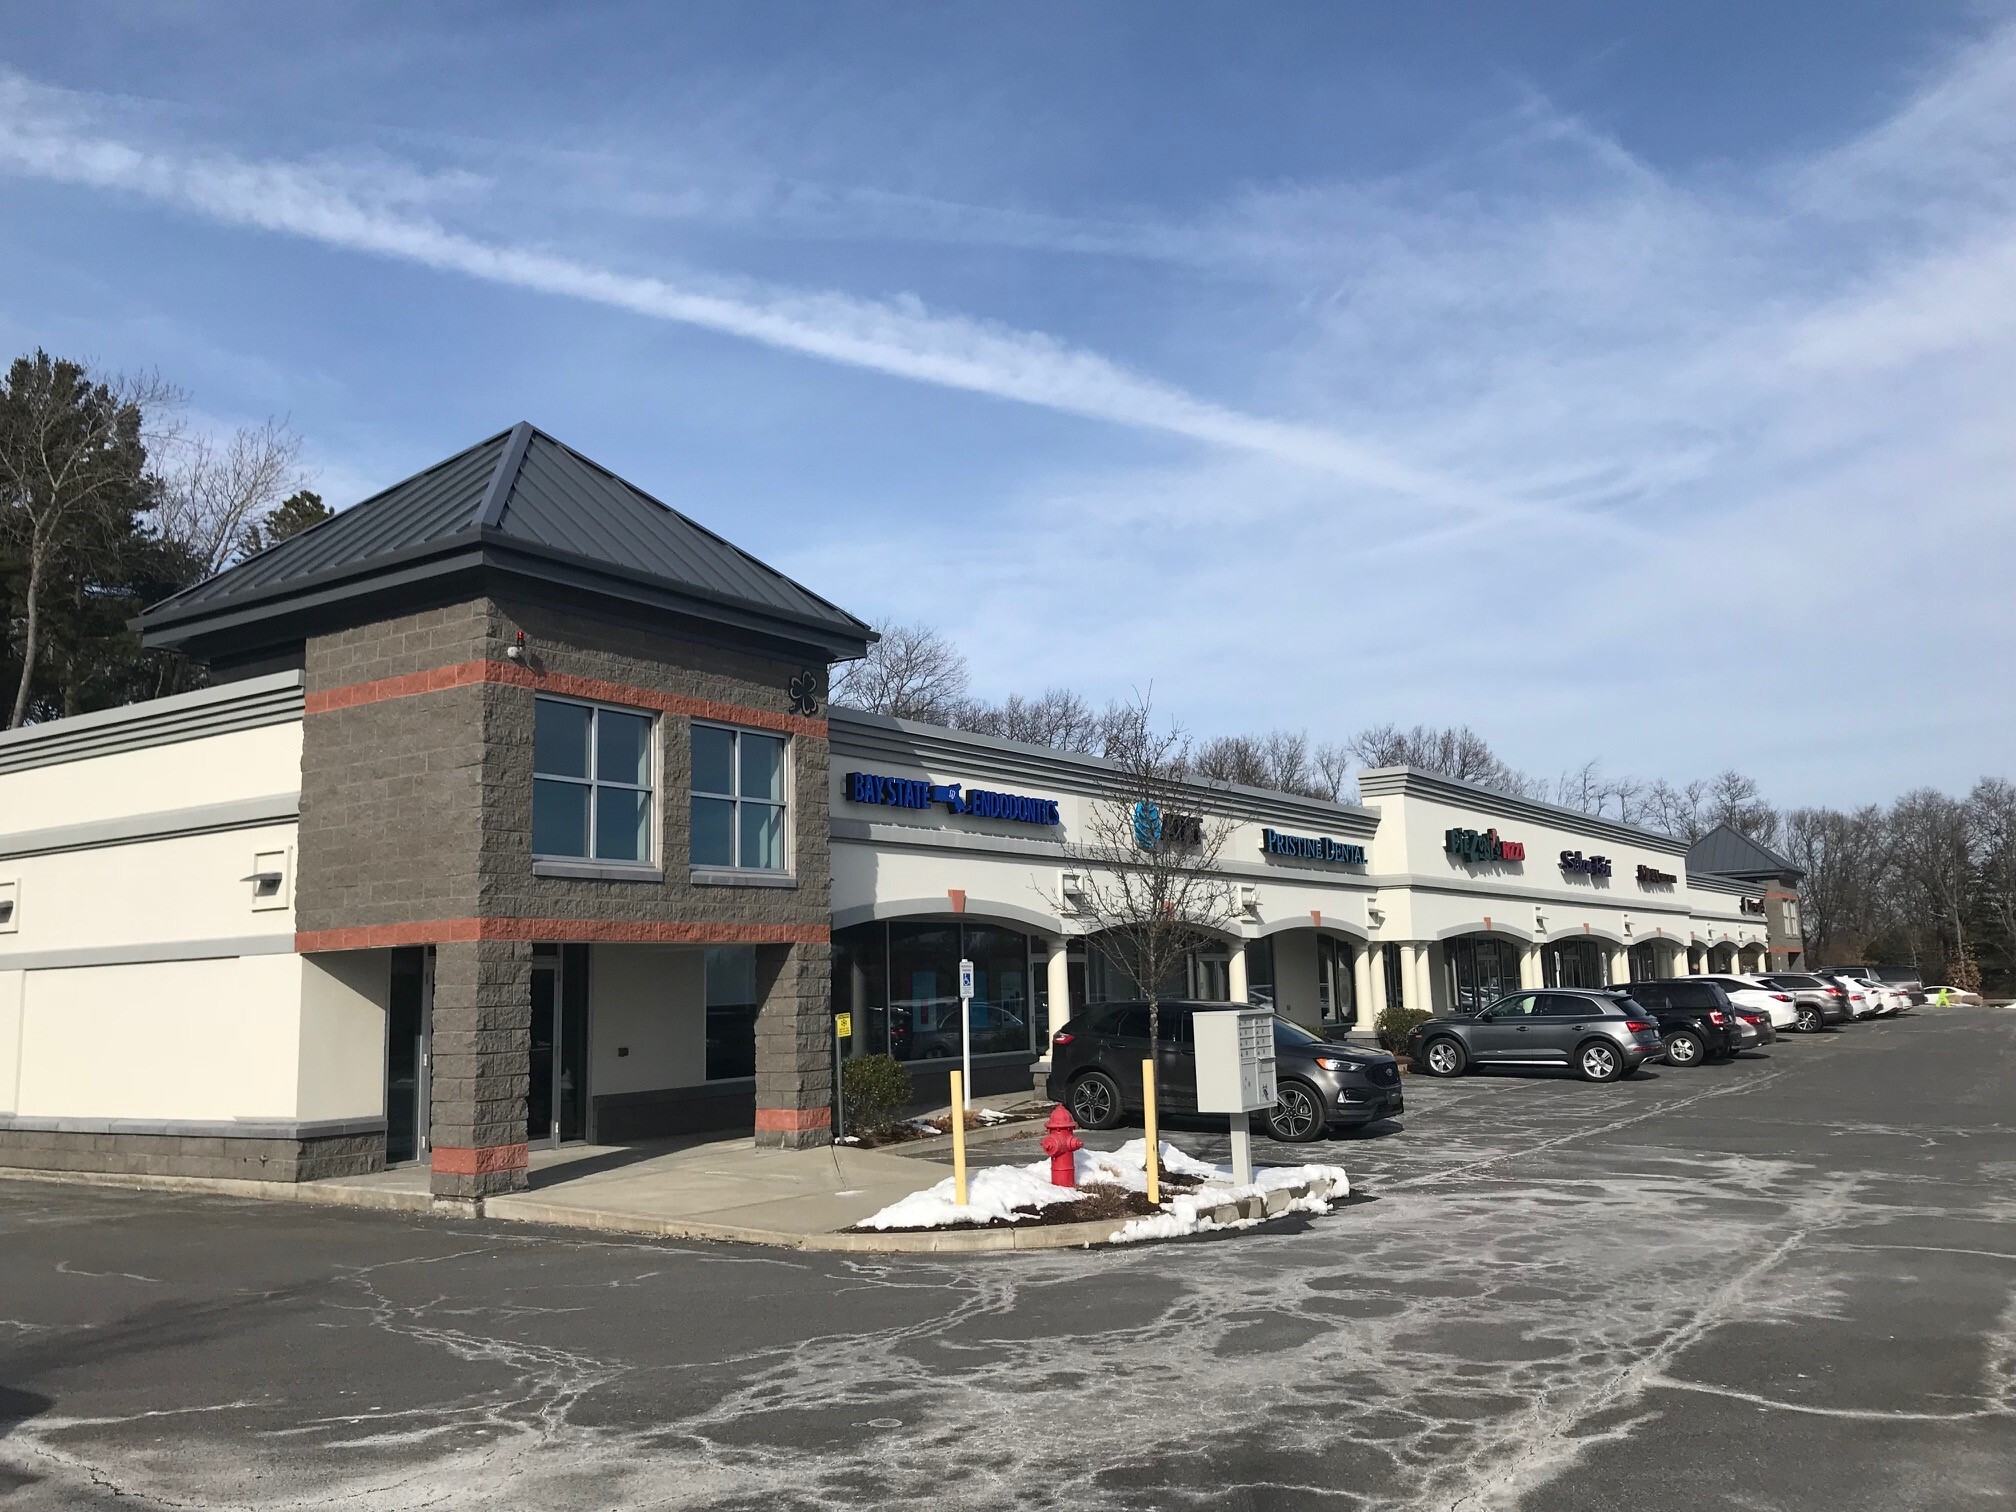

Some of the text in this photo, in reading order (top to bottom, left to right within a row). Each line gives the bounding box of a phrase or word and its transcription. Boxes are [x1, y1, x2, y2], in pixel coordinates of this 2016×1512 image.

[851, 771, 1060, 826] BAY STATE ENDODONTICS
[1265, 828, 1369, 865] PRISTINE DENTAL
